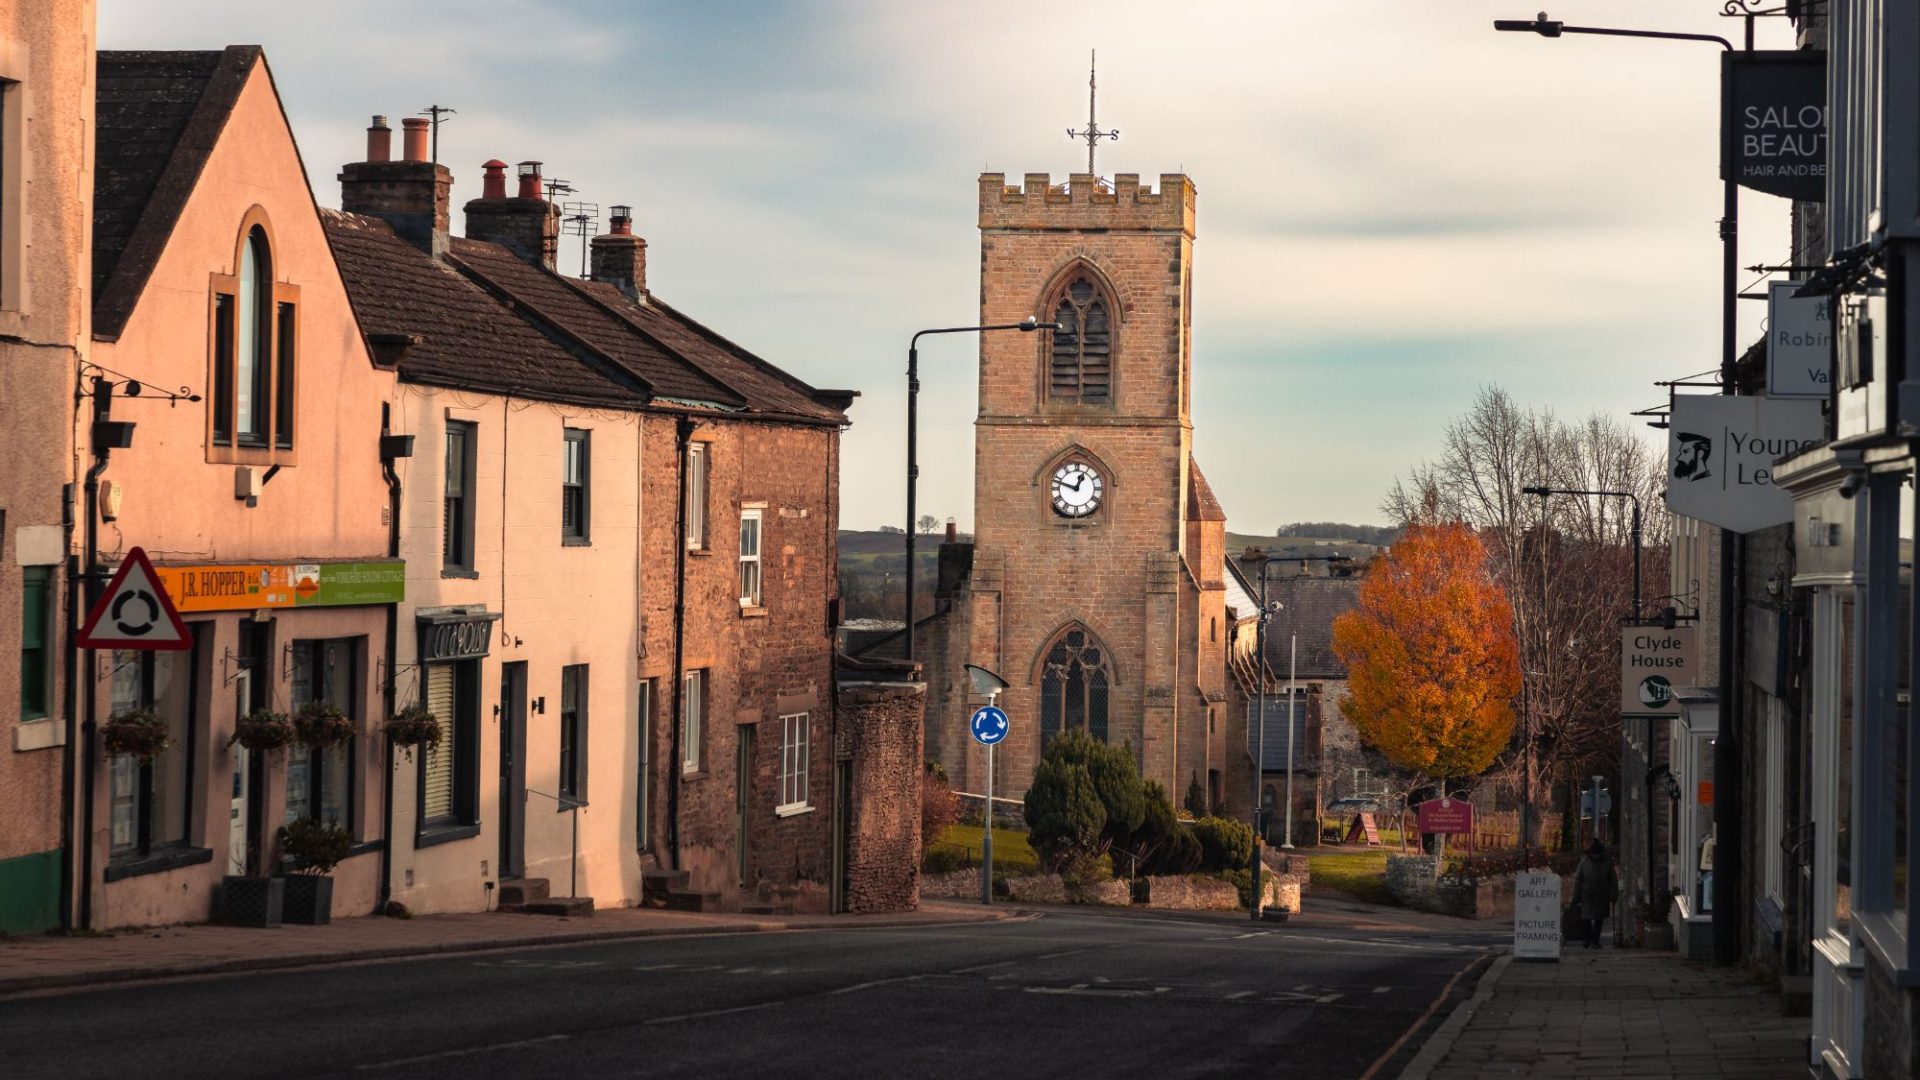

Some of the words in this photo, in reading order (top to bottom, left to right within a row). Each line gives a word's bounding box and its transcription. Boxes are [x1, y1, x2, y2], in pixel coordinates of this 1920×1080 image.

[1744, 165, 1775, 176] HAIR
[1777, 165, 1808, 176] AND
[1808, 368, 1831, 383] Va
[1738, 463, 1778, 485] Le
[200, 571, 246, 597] HOPPER
[1634, 636, 1681, 652] Clyde
[1631, 654, 1684, 668] House
[1529, 877, 1547, 886] ART
[1518, 889, 1558, 898] GALLERY
[1519, 920, 1556, 929] PICTURE
[1516, 932, 1558, 941] FRAMING
